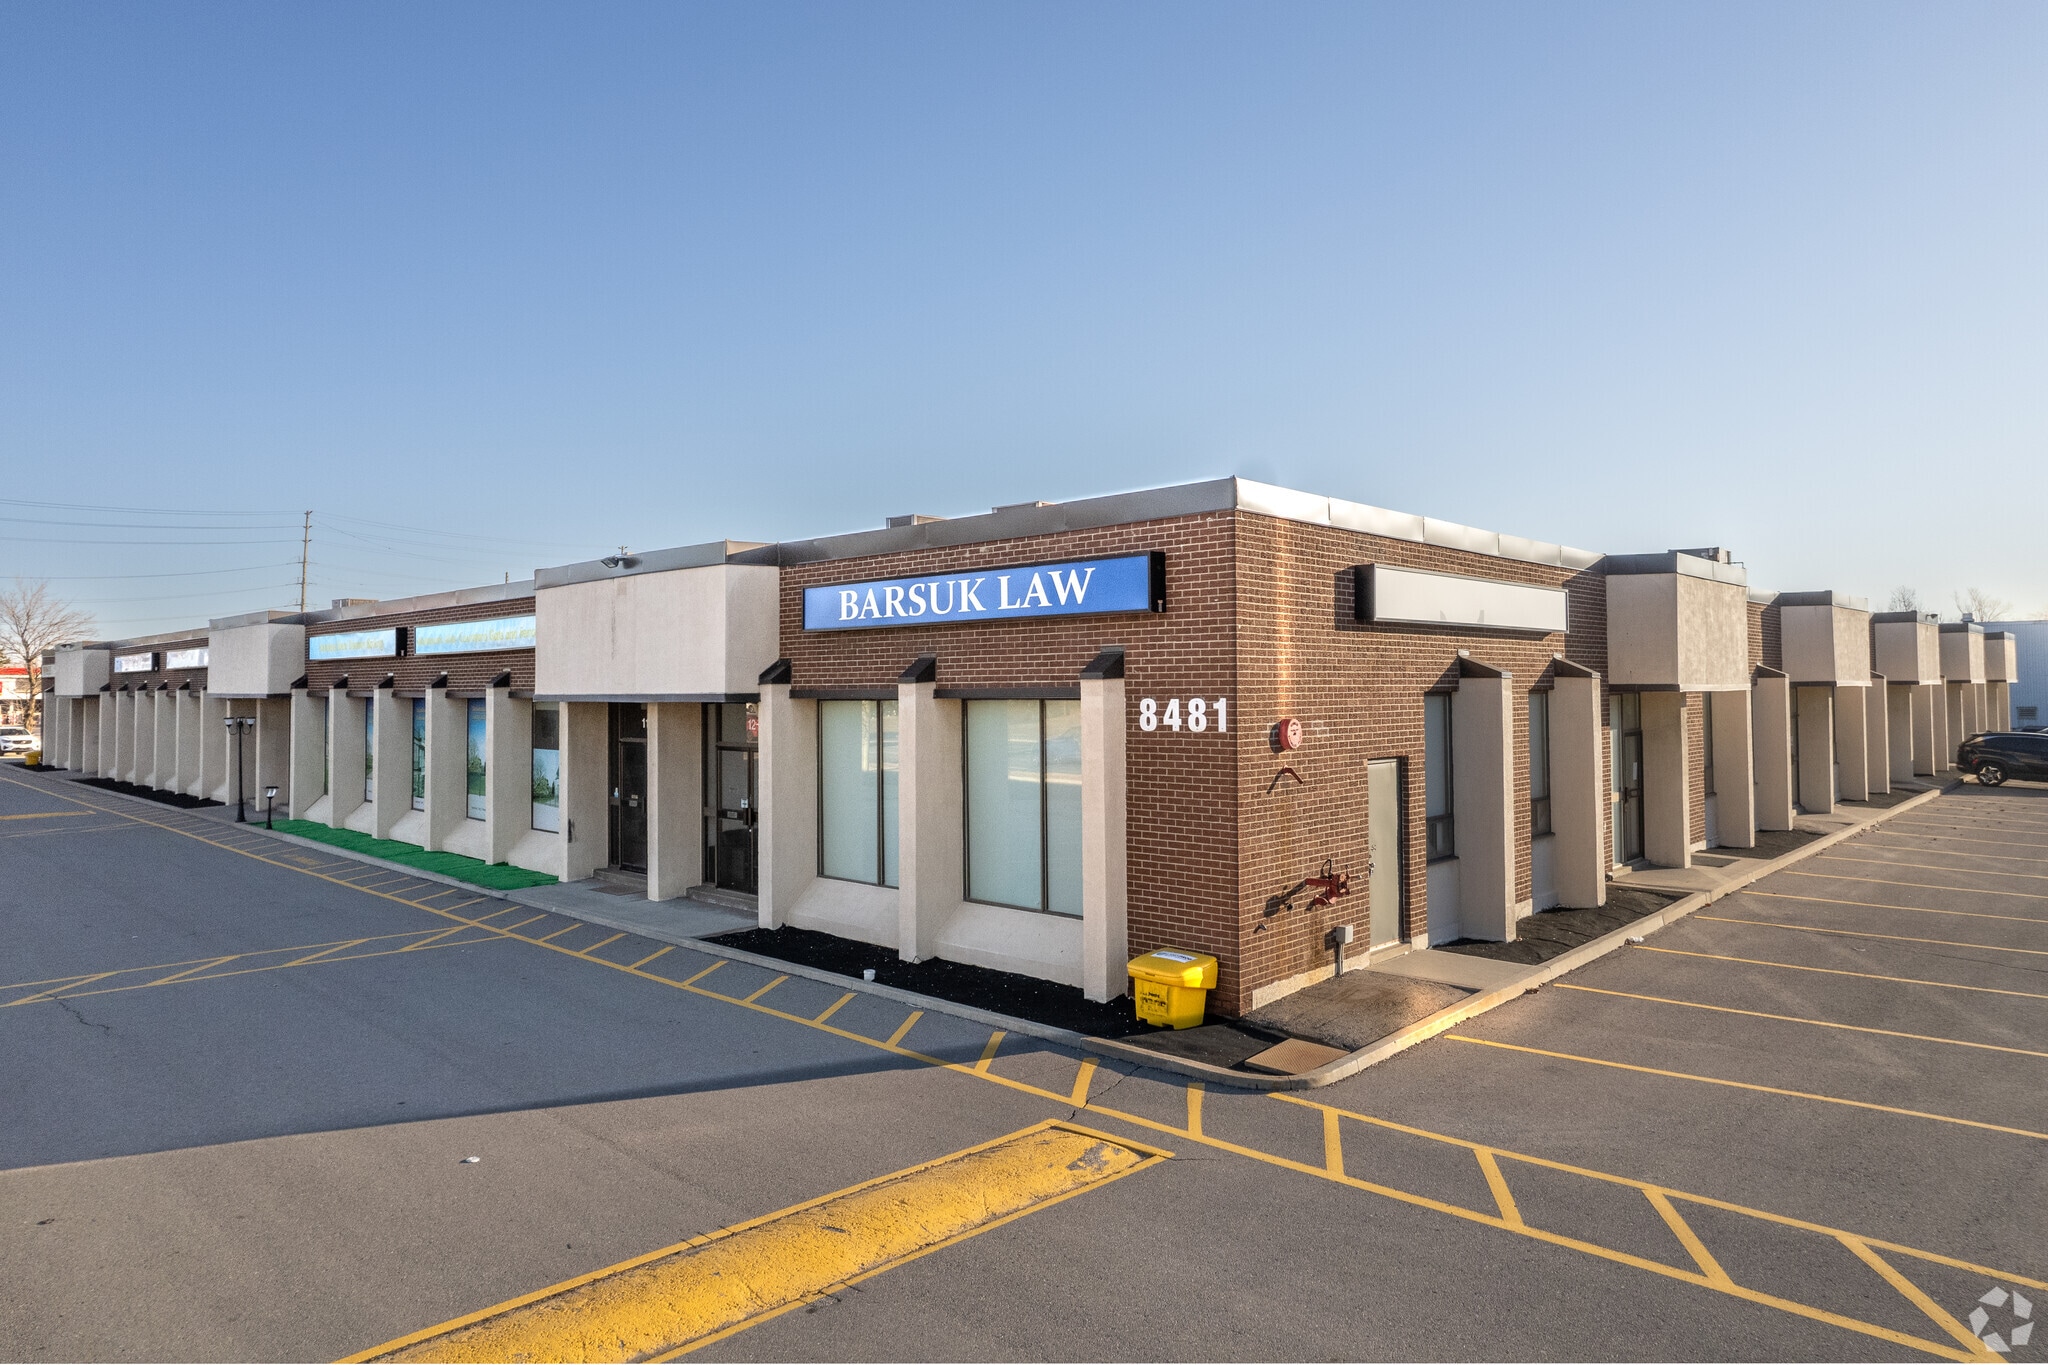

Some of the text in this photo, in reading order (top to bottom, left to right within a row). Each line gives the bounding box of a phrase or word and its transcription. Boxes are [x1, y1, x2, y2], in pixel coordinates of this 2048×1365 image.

[838, 567, 1096, 621] BARSUK LAW
[1139, 698, 1227, 733] 8481
